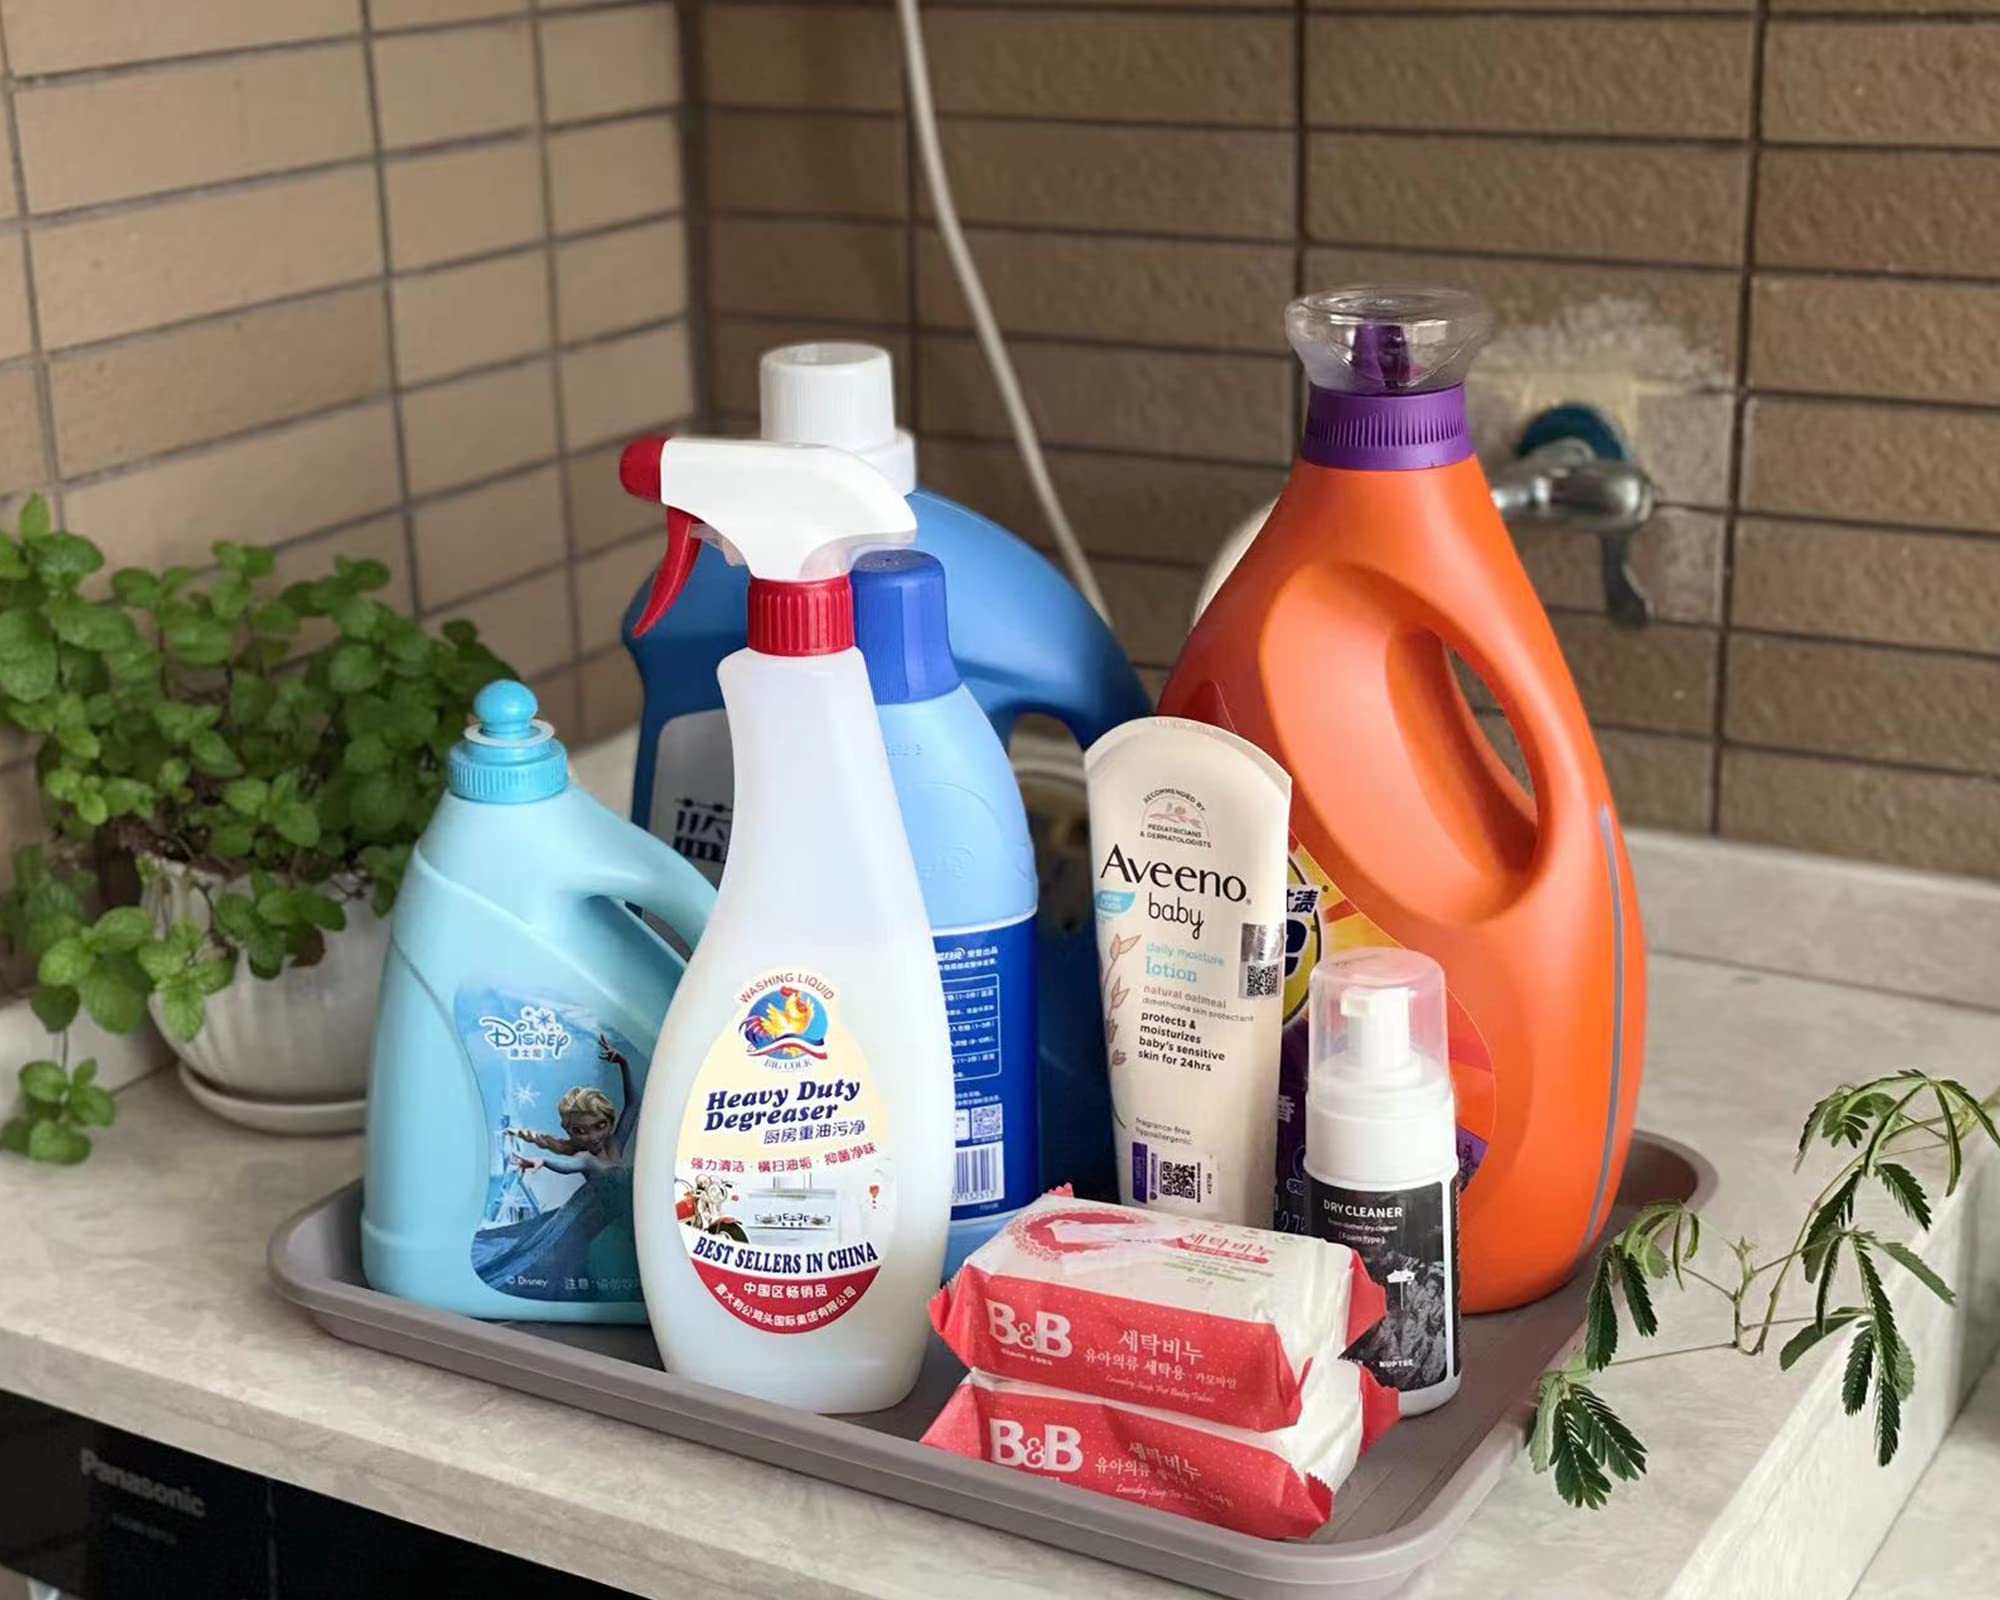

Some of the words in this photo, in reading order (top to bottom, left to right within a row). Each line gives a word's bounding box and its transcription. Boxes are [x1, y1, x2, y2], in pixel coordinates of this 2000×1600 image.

[1143, 788, 1195, 804] RECOMMENDED
[1196, 800, 1206, 811] BY
[1147, 832, 1211, 848] DERMATOLOGISTS
[1148, 824, 1202, 838] PEDIATRICIANS
[1100, 843, 1247, 902] Aveeno
[1148, 892, 1204, 939] baby
[1146, 942, 1175, 956] daily
[1177, 948, 1224, 966] moisture
[1145, 957, 1198, 983] lotion
[739, 972, 794, 1004] WASHING
[797, 974, 835, 1000] LIQUID
[1143, 984, 1182, 999] natural
[1184, 992, 1226, 1009] oatmeal
[1141, 1012, 1186, 1028] protects
[1189, 1020, 1196, 1030] &
[1142, 997, 1191, 1013] dimethicone
[1192, 1006, 1207, 1016] skin
[1208, 1010, 1254, 1022] protectant
[1140, 1025, 1201, 1044] moisturizes
[763, 1058, 783, 1071] BIG
[1138, 1050, 1159, 1061] skin
[1162, 1053, 1177, 1065] for
[1180, 1058, 1212, 1072] 24hrs
[1177, 1044, 1225, 1061] sensitive
[705, 1086, 789, 1112] Heavy
[796, 1077, 861, 1101] Duty
[704, 1102, 839, 1133] Degreaser
[763, 1119, 866, 1145] 厨房重油污净
[690, 1157, 745, 1173] 强力清洁
[824, 1142, 877, 1166] 抑菌净味
[1323, 1199, 1343, 1214] DRY
[1345, 1205, 1403, 1218] CLEANER
[693, 1236, 730, 1265] BEST
[734, 1247, 801, 1275] SELLERS
[806, 1253, 824, 1273] IN
[828, 1241, 878, 1271] CHINA
[517, 1276, 548, 1288] Disney
[744, 1281, 828, 1299] 中国区畅销品
[984, 1298, 1073, 1358] B&B
[1118, 1329, 1204, 1366] 세탁비누
[1084, 1348, 1139, 1371] 유아의류
[1144, 1360, 1185, 1381] 세탁용
[989, 1418, 1083, 1472] B&B
[1095, 1456, 1150, 1477] 유아의류
[79, 1447, 206, 1518] Panasonic
